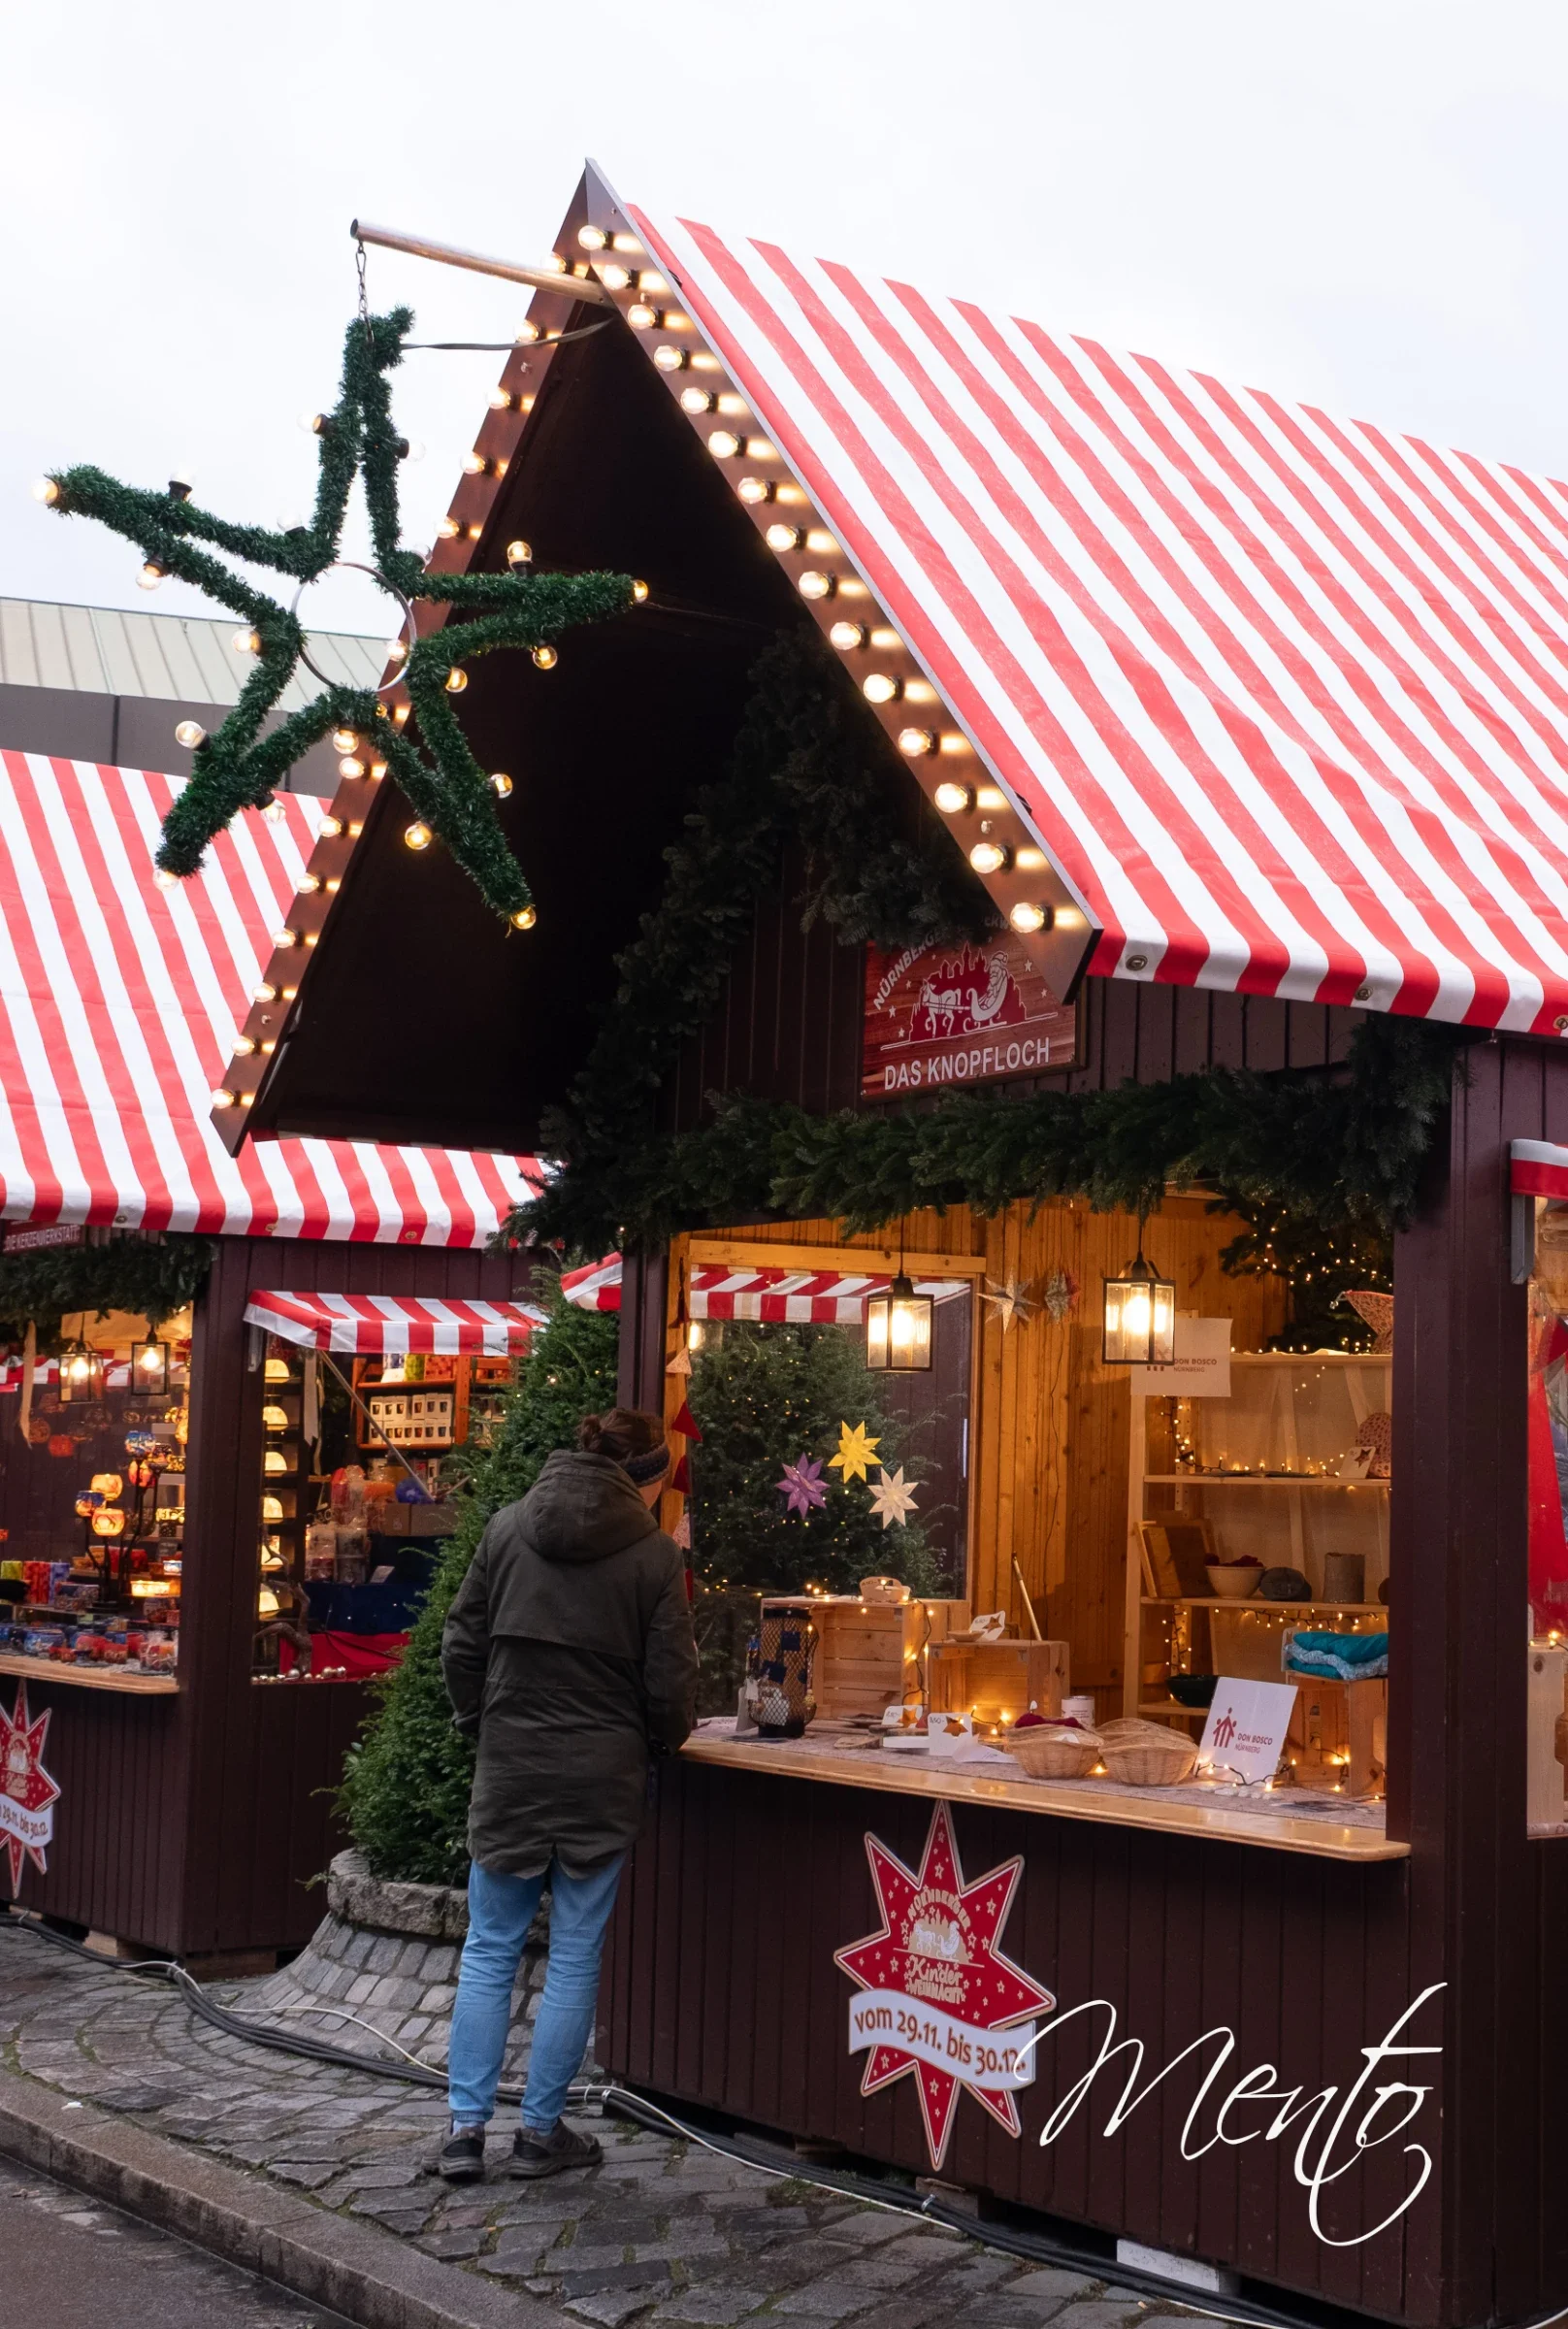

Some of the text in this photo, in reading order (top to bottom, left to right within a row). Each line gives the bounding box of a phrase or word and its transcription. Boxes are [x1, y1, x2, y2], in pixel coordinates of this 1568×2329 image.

[884, 1036, 1050, 1091] DAS KNOPFLOCH
[1237, 1732, 1273, 1745] DON BOSCO
[910, 1955, 964, 1986] Kinder
[854, 2007, 893, 2034] vom
[897, 2010, 942, 2051] 29.11.
[946, 2026, 972, 2066] bis
